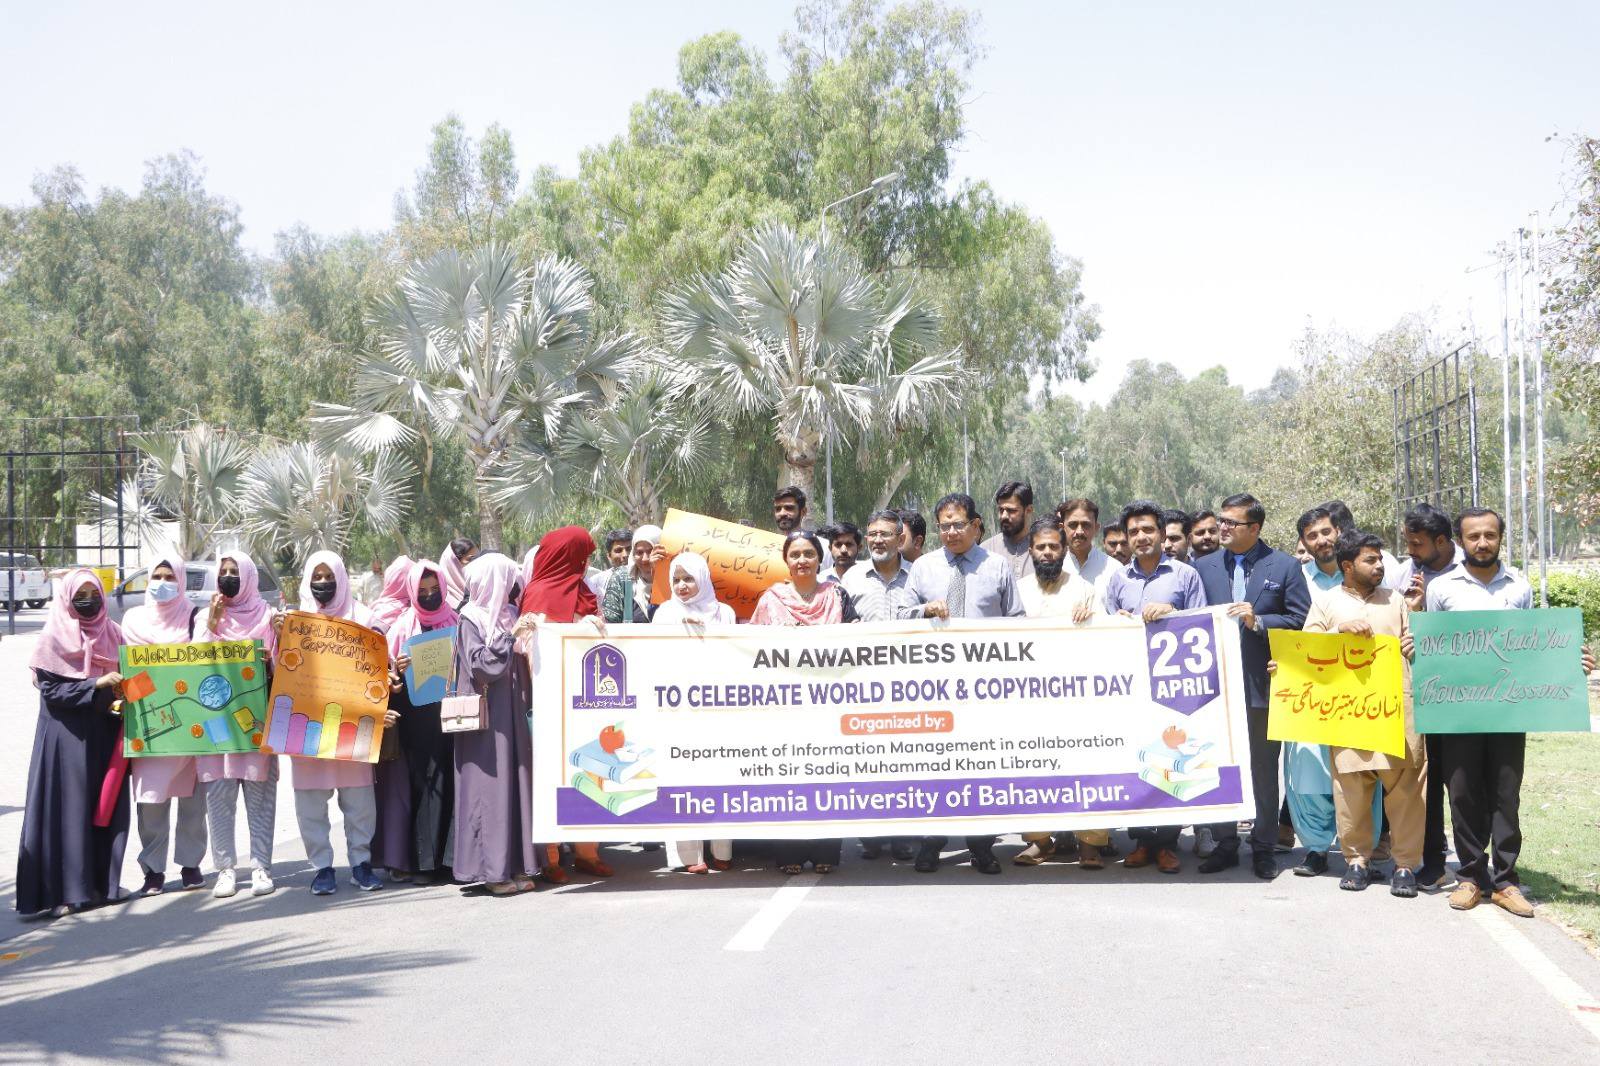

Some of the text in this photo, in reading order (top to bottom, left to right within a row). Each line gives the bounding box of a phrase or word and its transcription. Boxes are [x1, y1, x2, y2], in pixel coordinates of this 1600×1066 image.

[222, 644, 254, 660] DAY
[752, 641, 1036, 668] AN AWARENESS WALK
[1149, 627, 1214, 677] 23
[1420, 632, 1448, 656] ONE
[354, 660, 382, 677] DAY
[1306, 642, 1388, 672] کتاب
[654, 685, 682, 707] TO
[687, 683, 803, 707] CELEBRATE
[808, 681, 885, 705] WORLD
[891, 679, 950, 702] BOOK
[955, 678, 969, 700] &
[974, 676, 1088, 700] COPYRIGHT
[1093, 674, 1134, 697] DAY
[1156, 676, 1215, 699] APRIL
[1354, 692, 1377, 718] کی
[1366, 695, 1401, 720] انسان
[849, 714, 946, 732] Organized by:
[670, 735, 1125, 762] Department of Information Management in collaboration
[739, 755, 1061, 777] with Sir Sadiq Muhammad Khan Library,
[670, 780, 1130, 815] The Islamia University of Bahawalpur.
